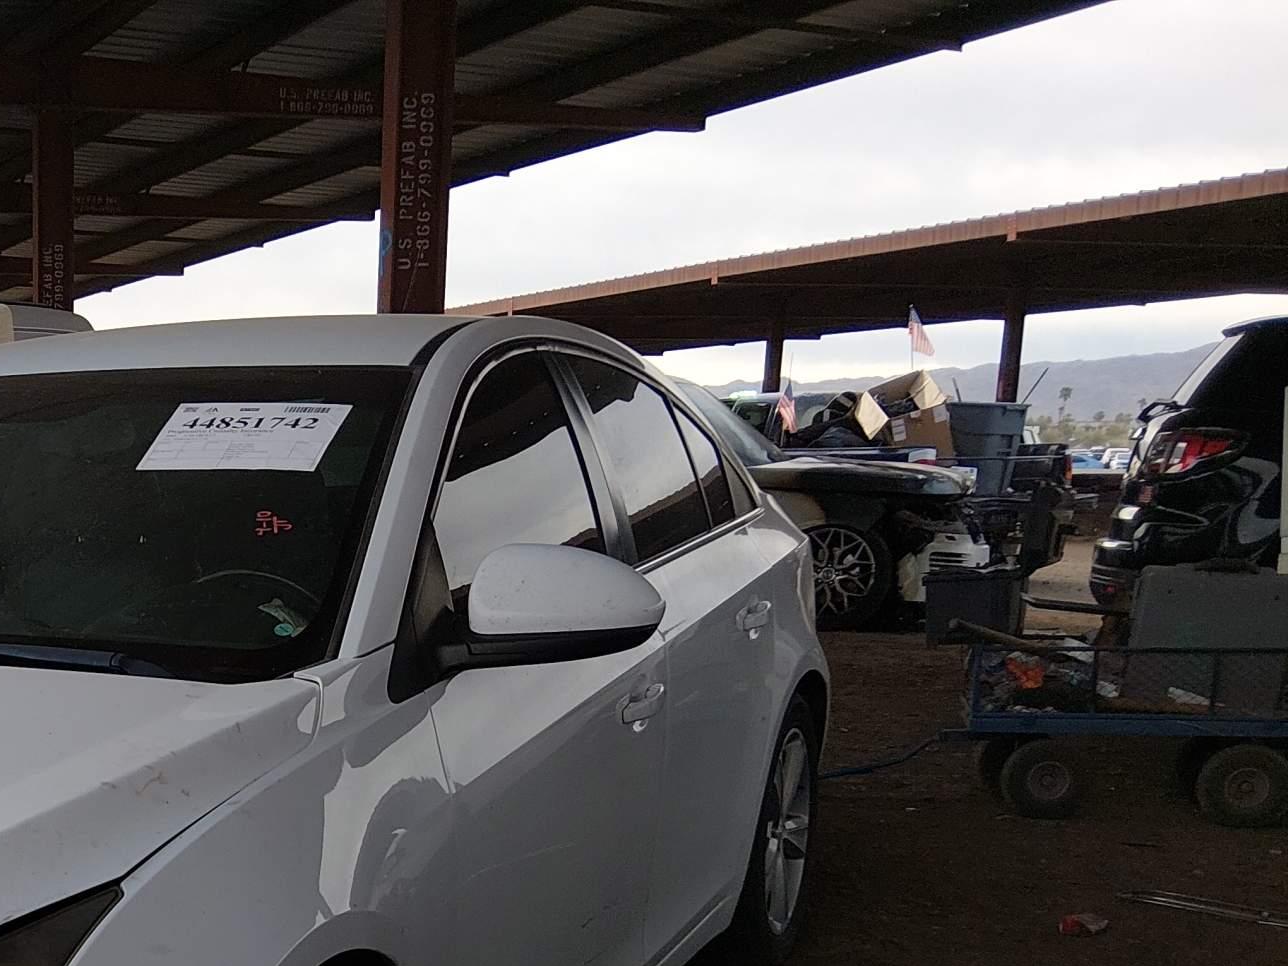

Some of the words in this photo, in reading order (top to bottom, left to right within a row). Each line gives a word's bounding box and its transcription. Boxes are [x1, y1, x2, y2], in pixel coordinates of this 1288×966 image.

[402, 91, 418, 129] INC.
[399, 141, 416, 220] PREFAB
[416, 92, 435, 268] 1-866-799-0969
[183, 417, 320, 429] 44851742
